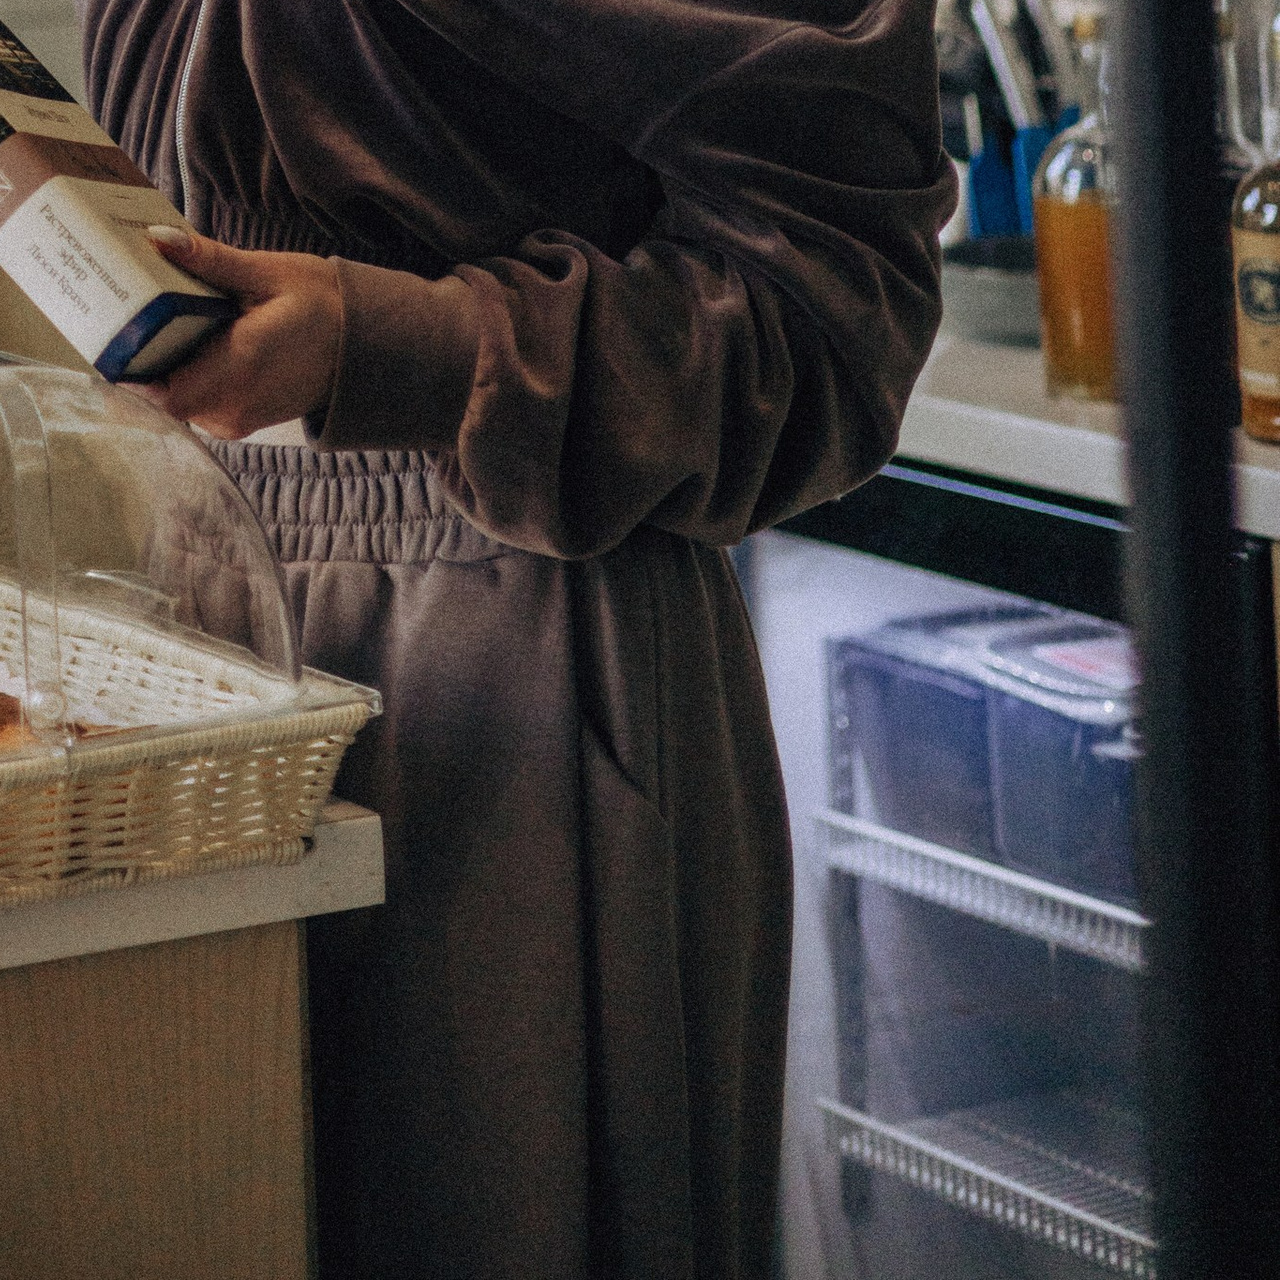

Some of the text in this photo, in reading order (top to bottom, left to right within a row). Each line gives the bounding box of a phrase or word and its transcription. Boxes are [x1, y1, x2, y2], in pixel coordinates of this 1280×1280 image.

[26, 243, 91, 315] Люси Краун
[40, 203, 129, 303] Растревоженный
[57, 245, 88, 283] эфир
